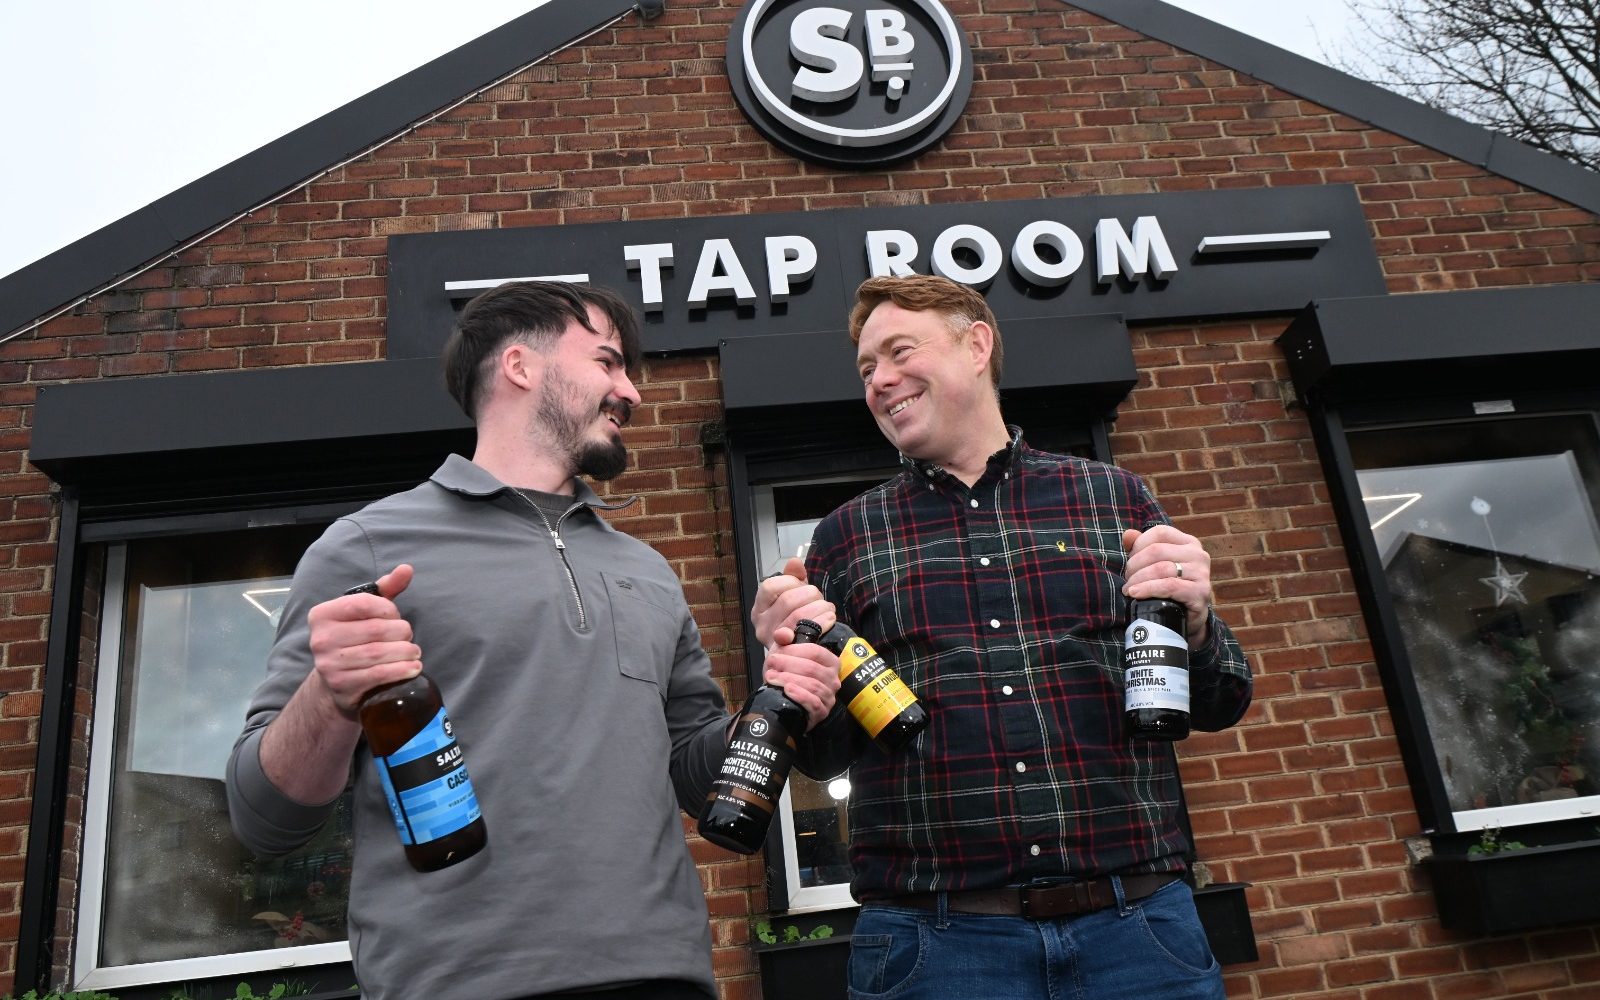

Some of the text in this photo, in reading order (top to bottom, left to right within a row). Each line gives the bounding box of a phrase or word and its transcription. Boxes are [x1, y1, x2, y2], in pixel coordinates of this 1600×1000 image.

[623, 215, 1178, 309] TAP ROOM
[1126, 649, 1165, 662] SALTAIRE
[855, 657, 886, 682] SALTAIR
[1131, 669, 1154, 679] WHITE
[730, 740, 778, 761] SALTAIRE
[720, 765, 745, 777] TRIPLE
[744, 770, 768, 786] CHOC
[723, 757, 771, 777] MONTEZUMA'S
